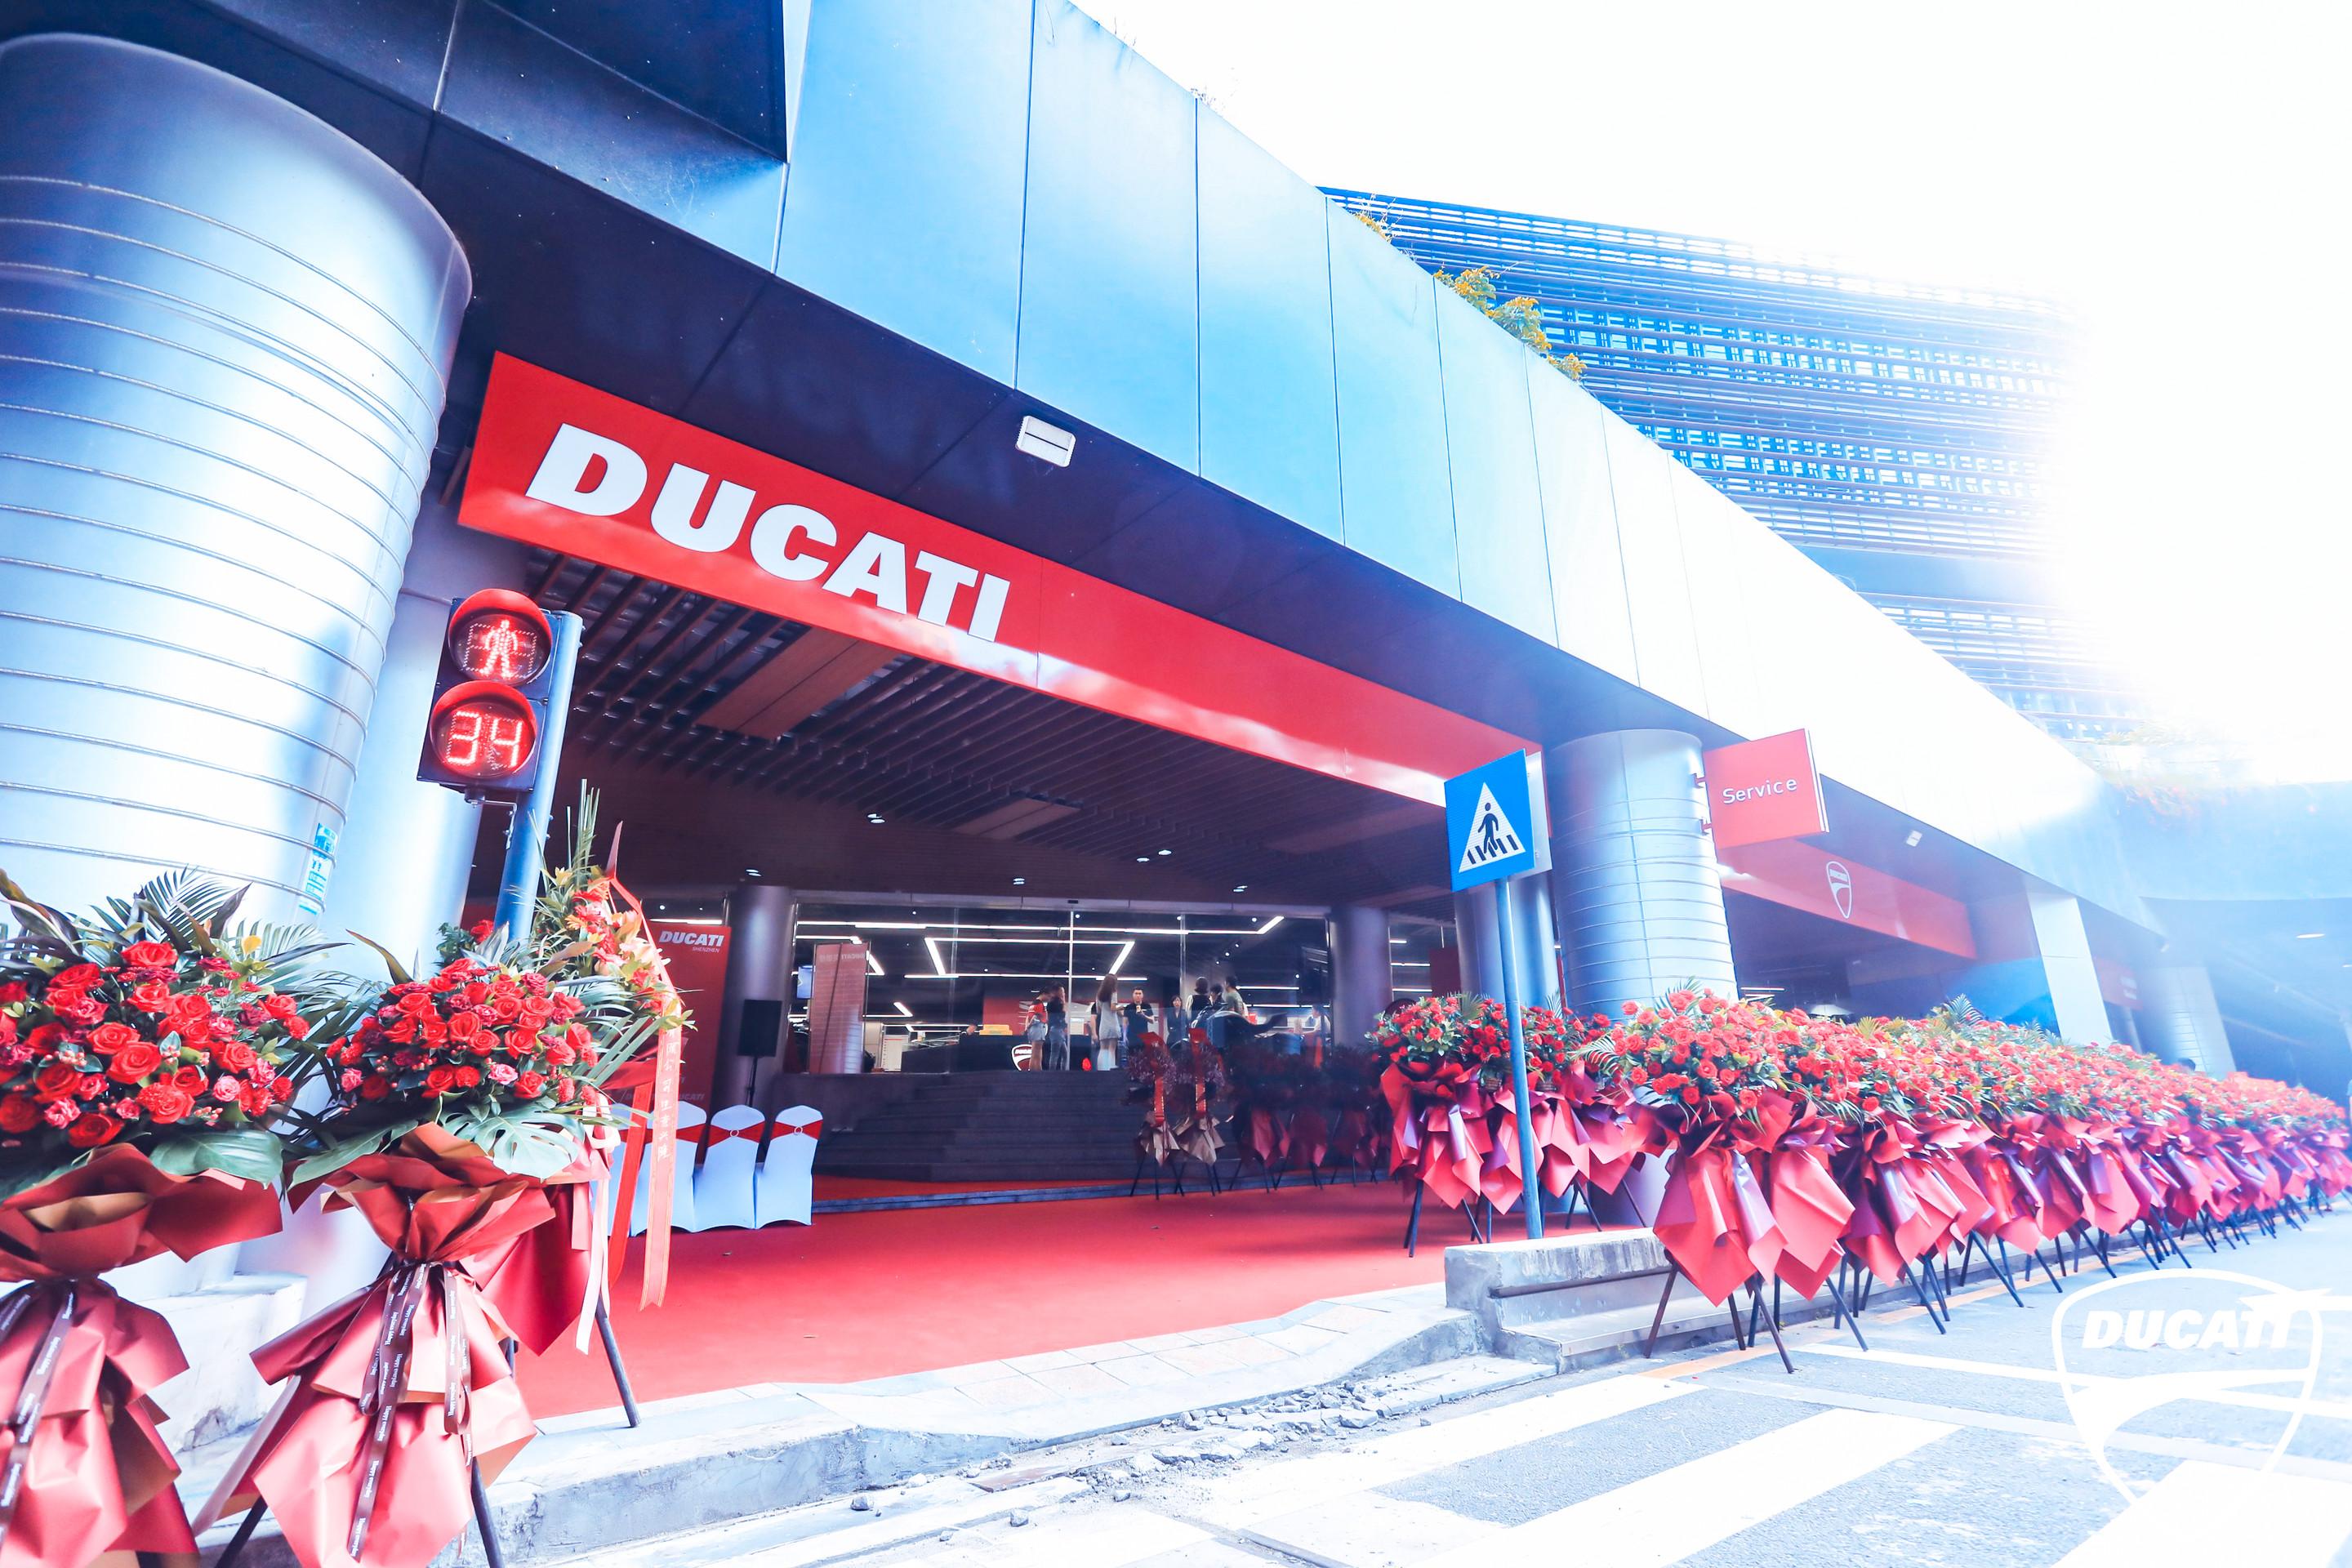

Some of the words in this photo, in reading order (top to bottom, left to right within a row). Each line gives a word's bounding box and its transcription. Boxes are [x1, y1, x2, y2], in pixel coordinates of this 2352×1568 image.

[525, 423, 1010, 642] DUCATI
[447, 710, 523, 768] 34
[1722, 777, 1797, 804] Service
[658, 931, 724, 947] DUCATI
